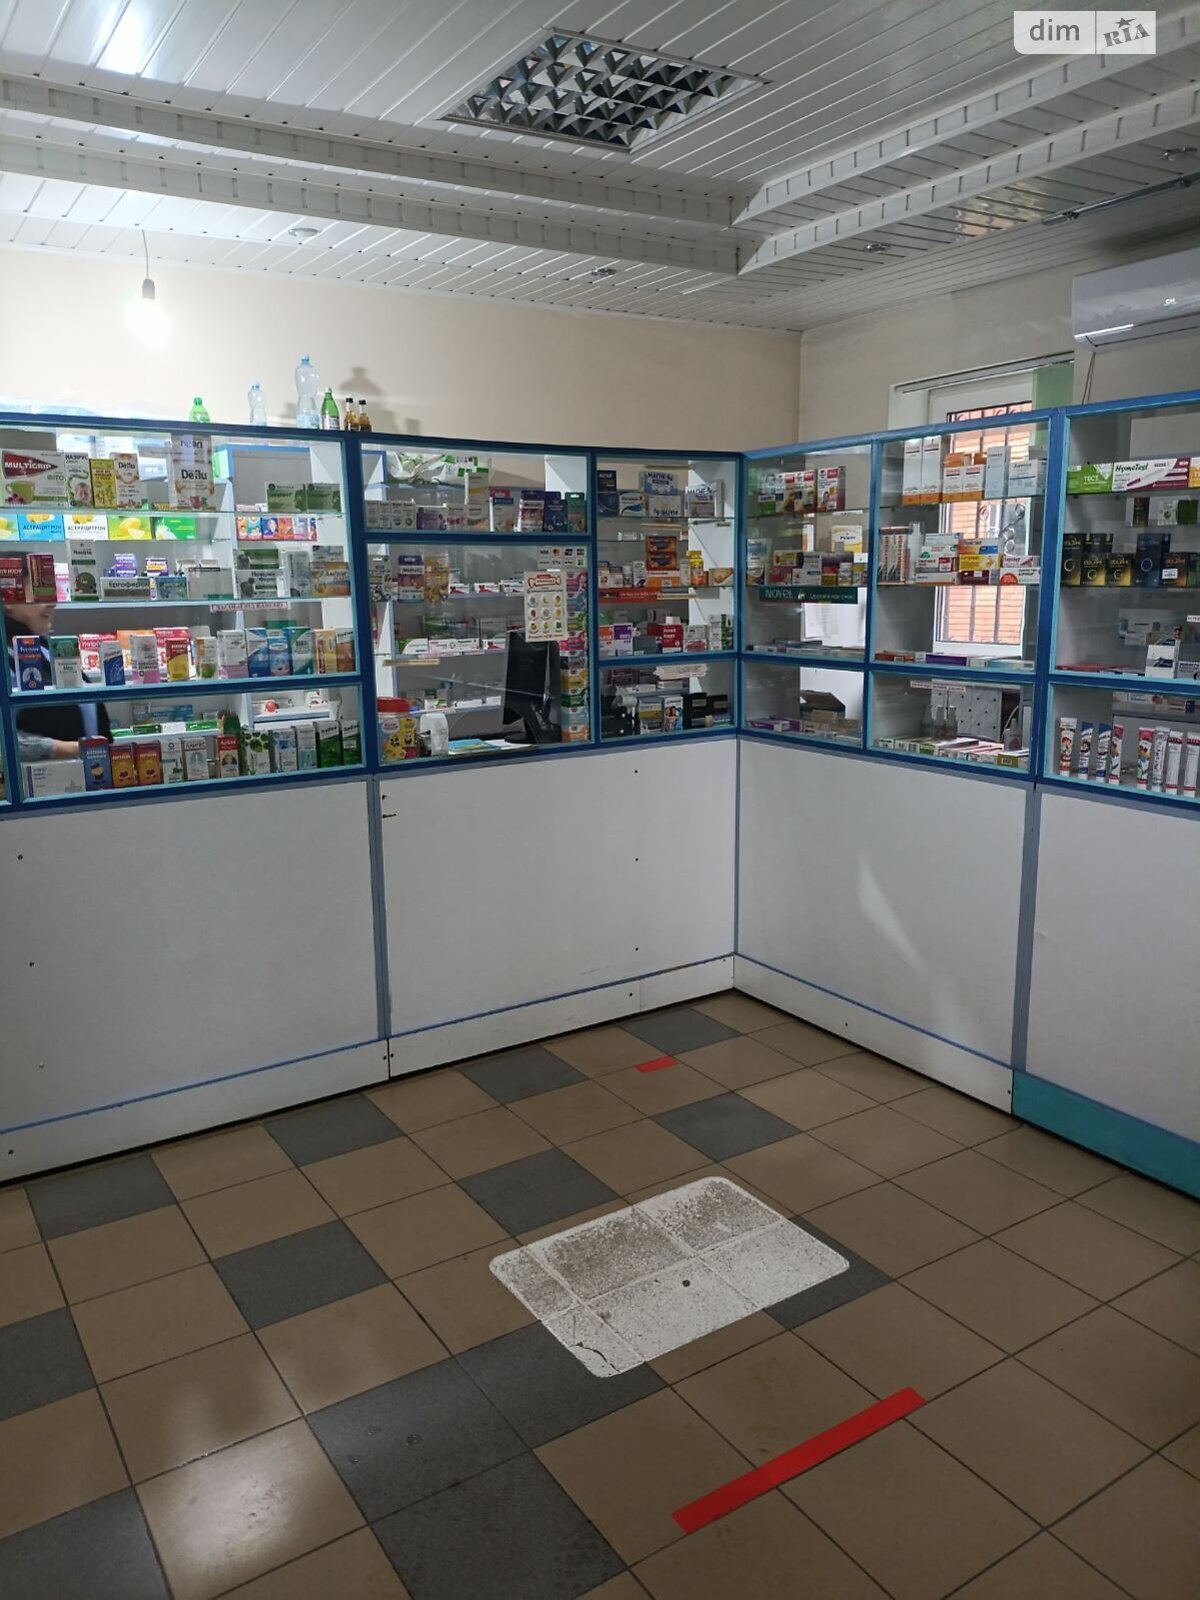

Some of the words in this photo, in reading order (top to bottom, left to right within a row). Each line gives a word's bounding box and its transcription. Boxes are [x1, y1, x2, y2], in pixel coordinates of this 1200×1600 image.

[4, 461, 52, 470] MULTIGRIP
[1115, 463, 1149, 473] HomeTest
[180, 469, 208, 480] Deflu
